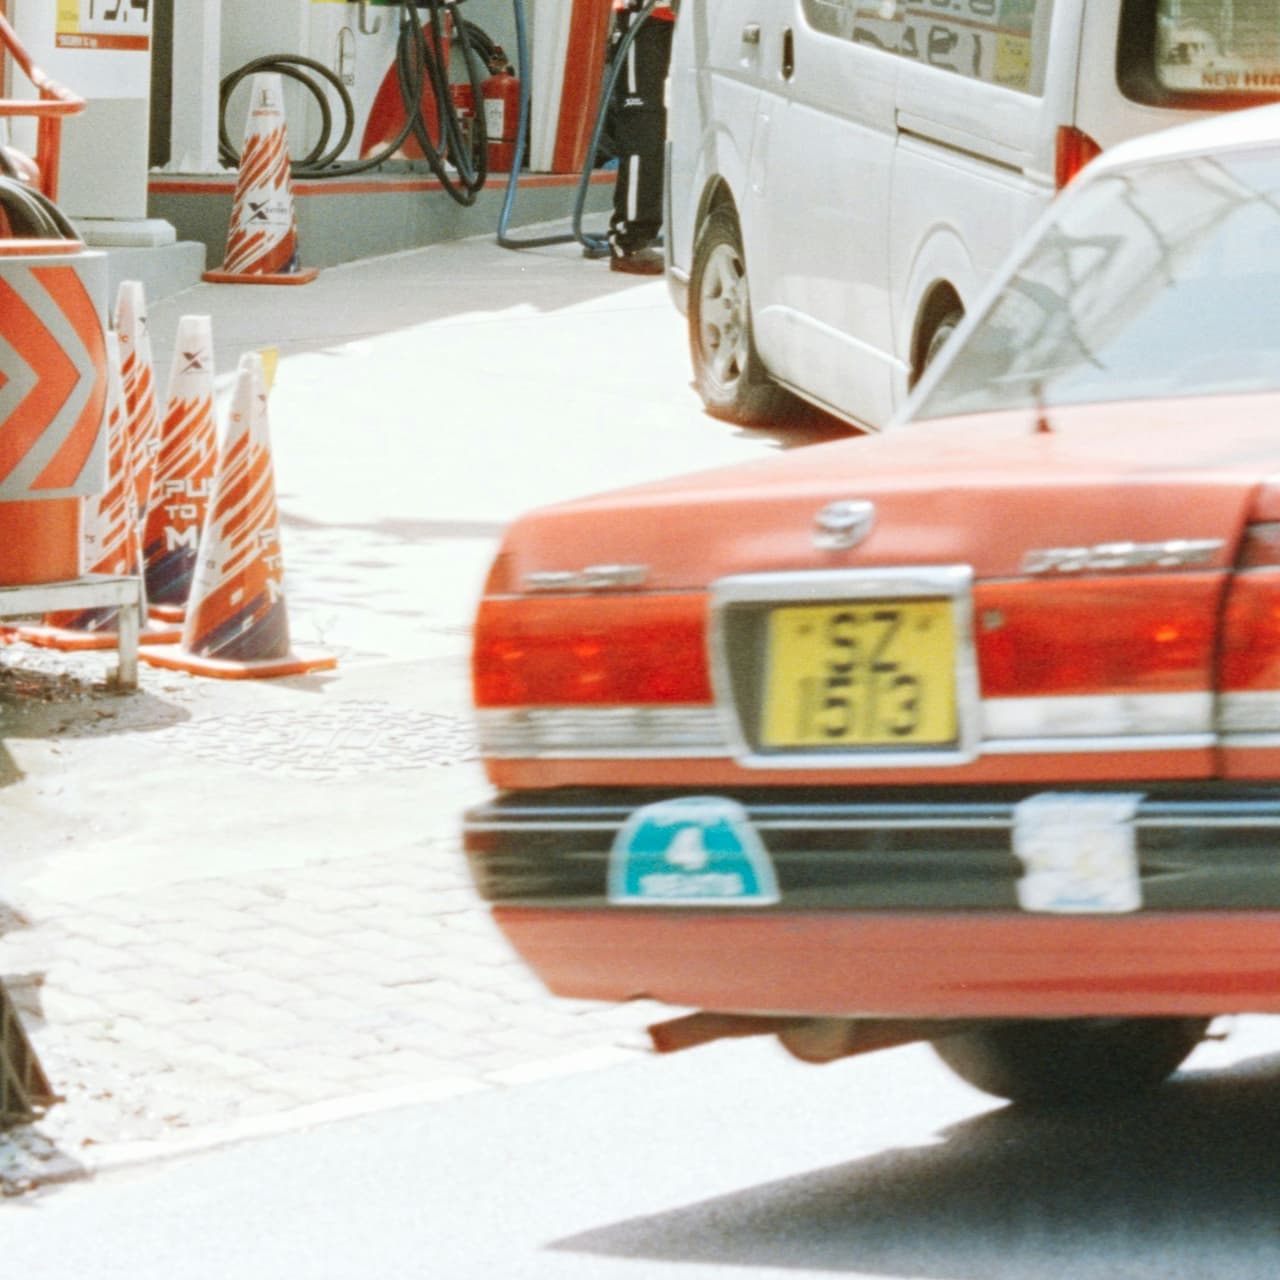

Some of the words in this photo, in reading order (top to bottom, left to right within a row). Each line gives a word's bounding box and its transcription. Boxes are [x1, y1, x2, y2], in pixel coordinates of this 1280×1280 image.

[1202, 72, 1239, 87] NEW
[165, 478, 211, 498] PU
[826, 611, 902, 674] SZ
